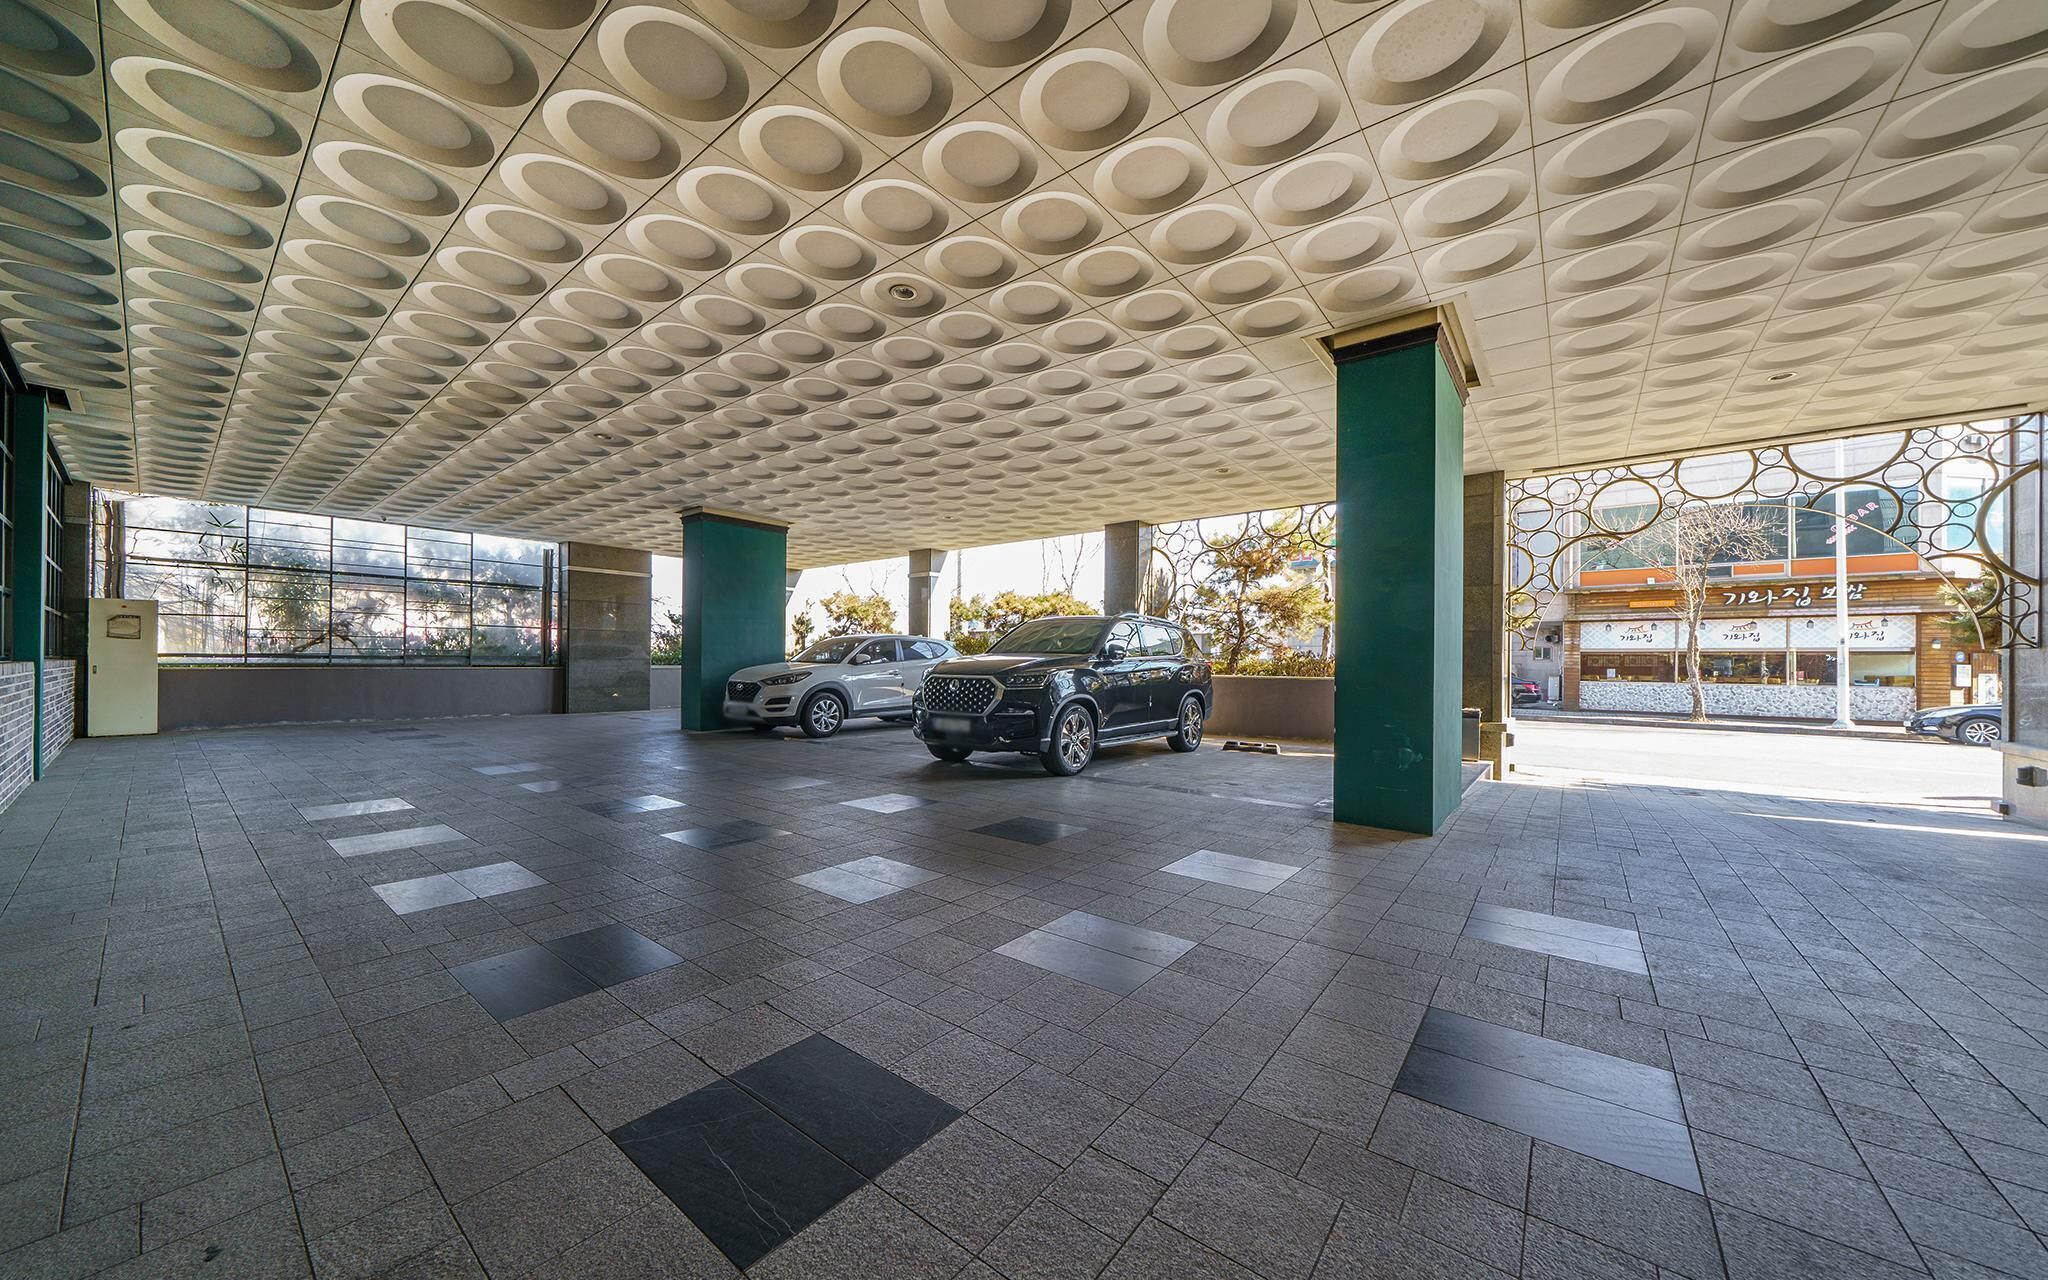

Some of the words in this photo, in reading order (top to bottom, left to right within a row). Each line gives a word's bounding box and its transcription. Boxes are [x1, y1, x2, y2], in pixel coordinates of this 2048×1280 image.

[1722, 586, 1812, 607] 기와집
[1619, 633, 1653, 643] 기와집
[1722, 632, 1761, 642] 기와집
